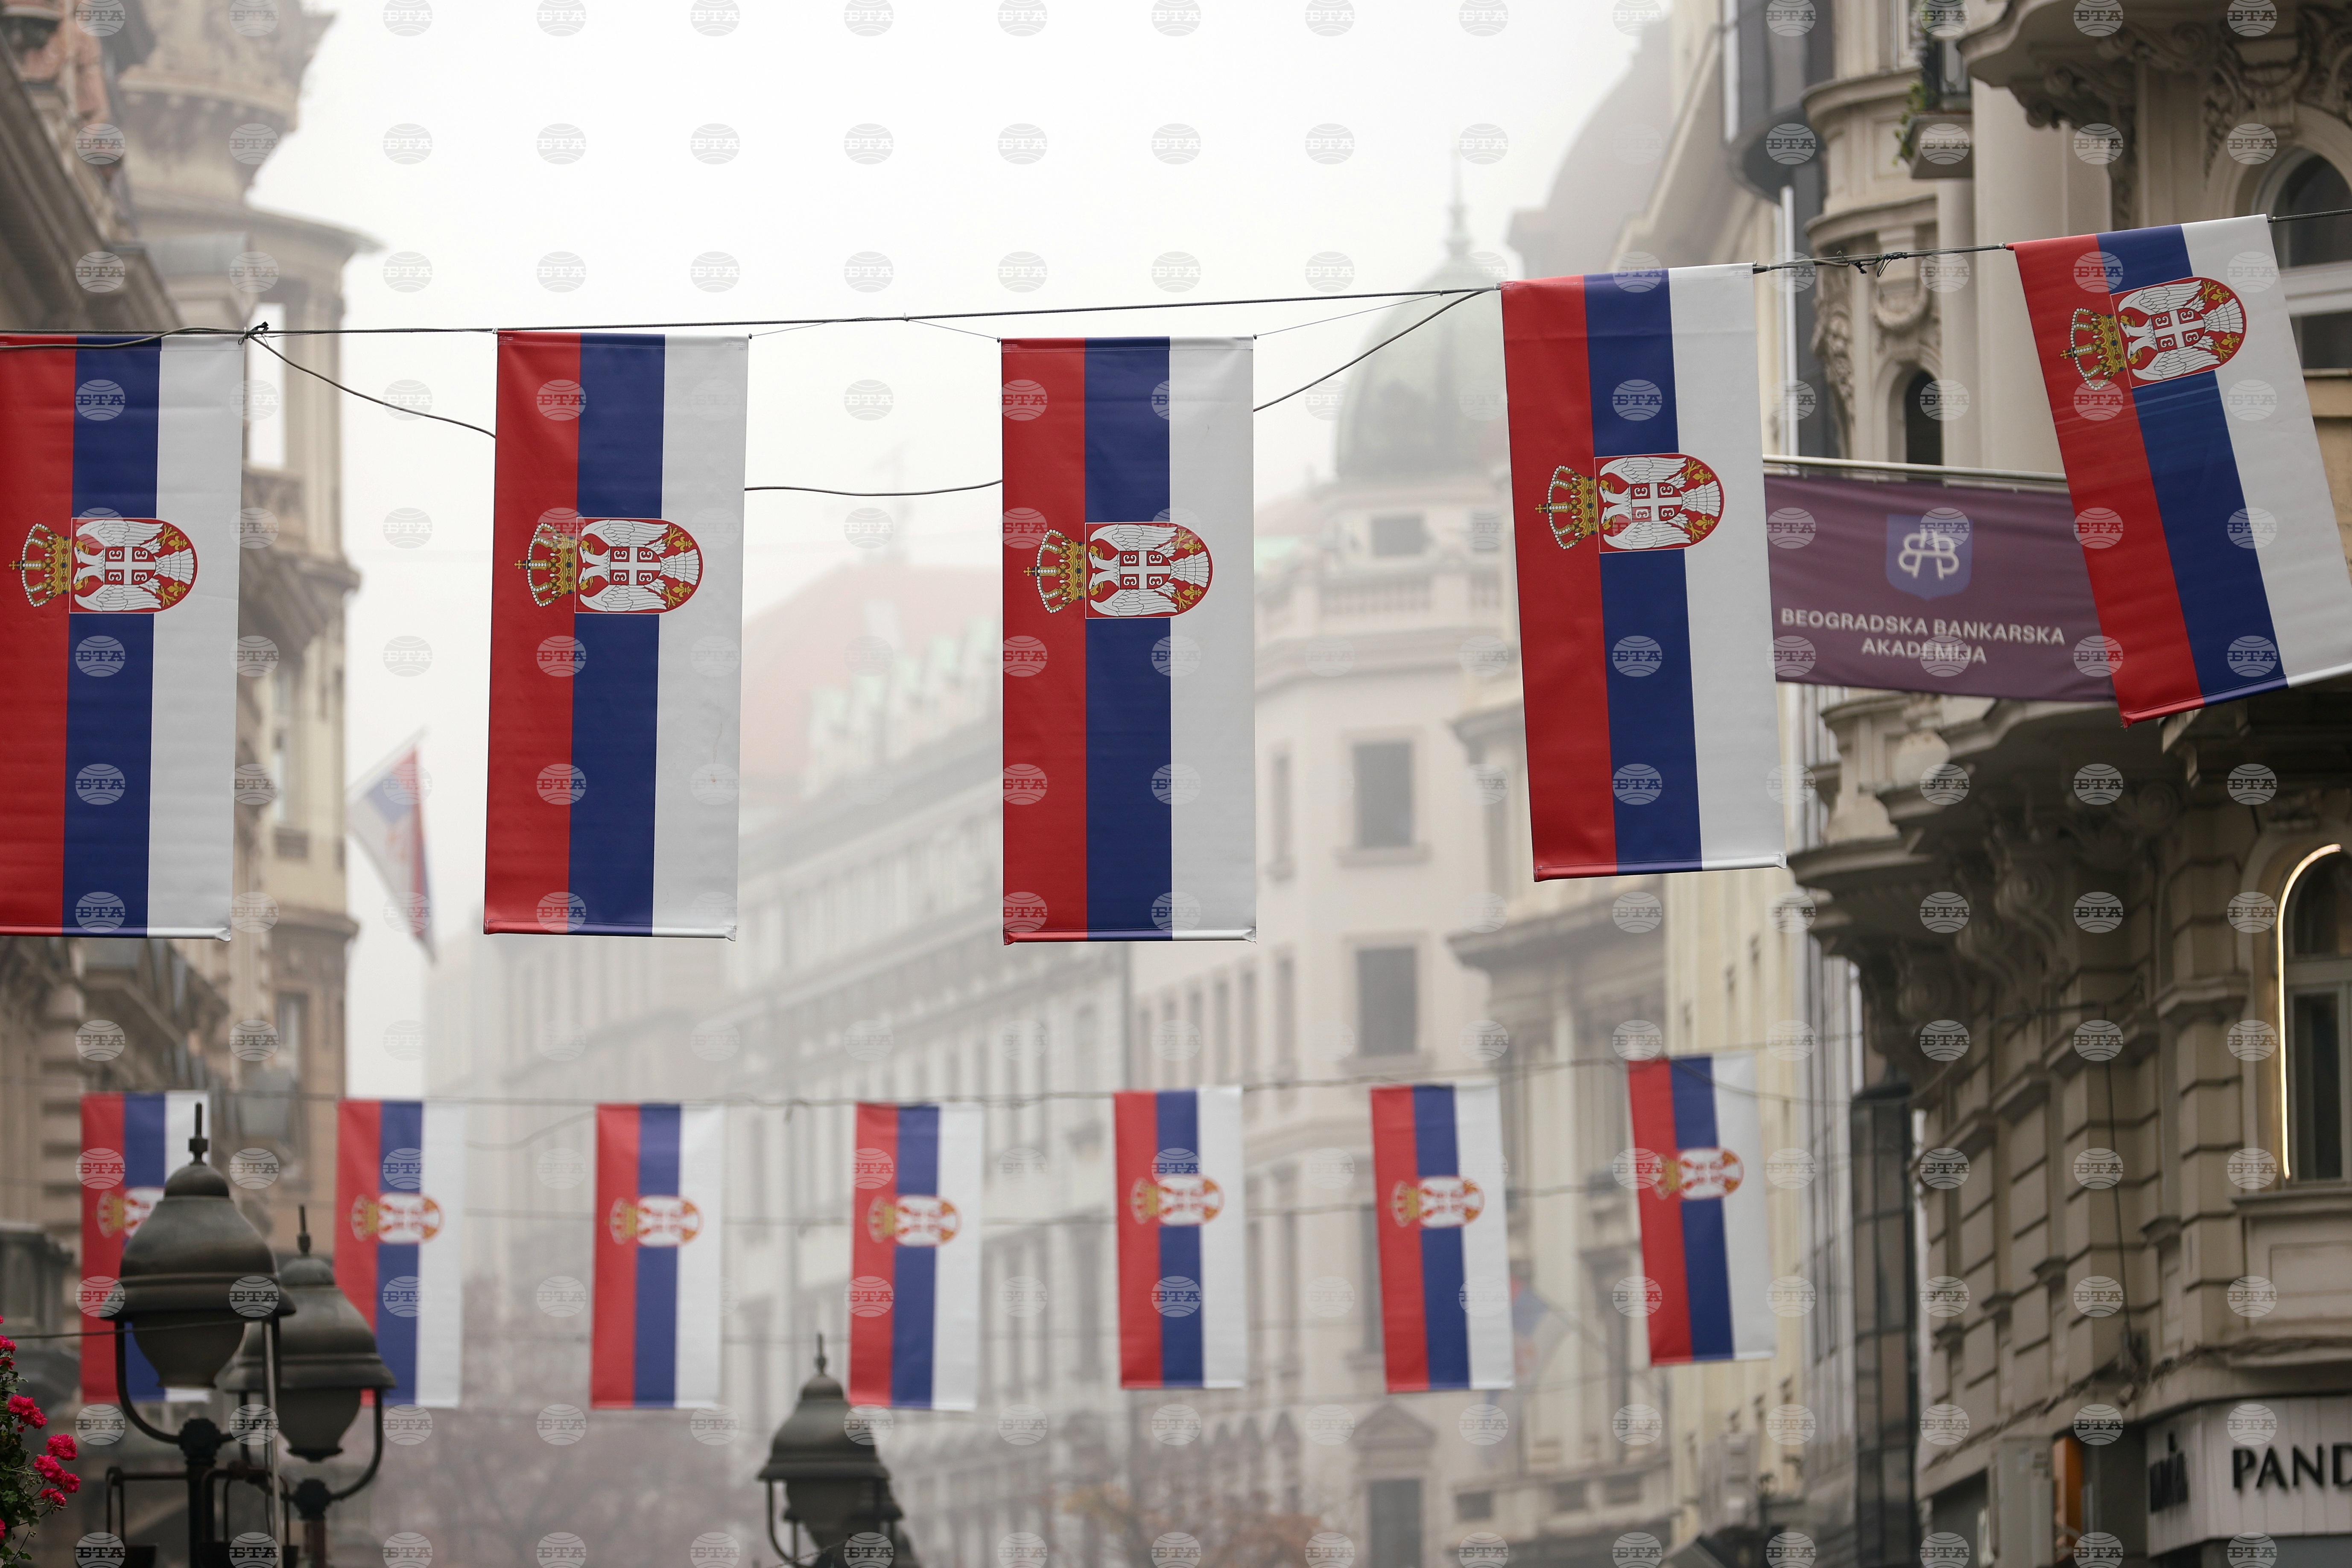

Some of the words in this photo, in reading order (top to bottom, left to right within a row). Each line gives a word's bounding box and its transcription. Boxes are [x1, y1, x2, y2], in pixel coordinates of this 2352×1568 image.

[1781, 608, 1928, 636] BEOGRADSKA
[1933, 619, 2066, 645] BANKARSKA
[1861, 637, 1987, 664] AKADEMIJA
